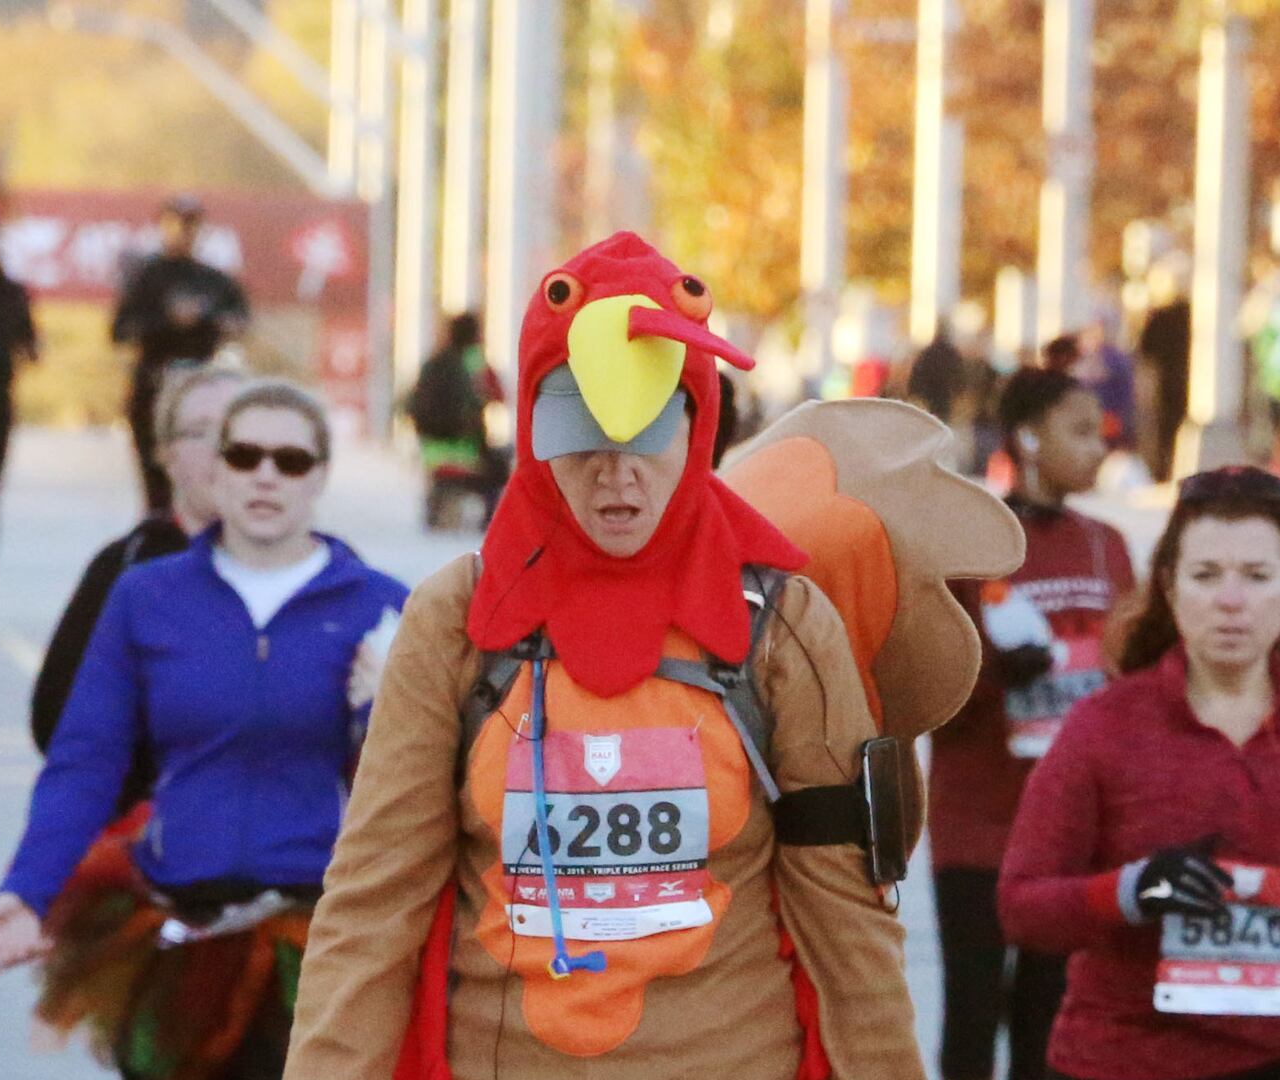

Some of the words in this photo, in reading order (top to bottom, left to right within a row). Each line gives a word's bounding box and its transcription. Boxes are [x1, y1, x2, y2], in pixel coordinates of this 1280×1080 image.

[527, 801, 682, 858] 6288
[593, 866, 621, 875] TRIPLE
[622, 865, 648, 874] PEACH
[671, 861, 697, 871] SERIES
